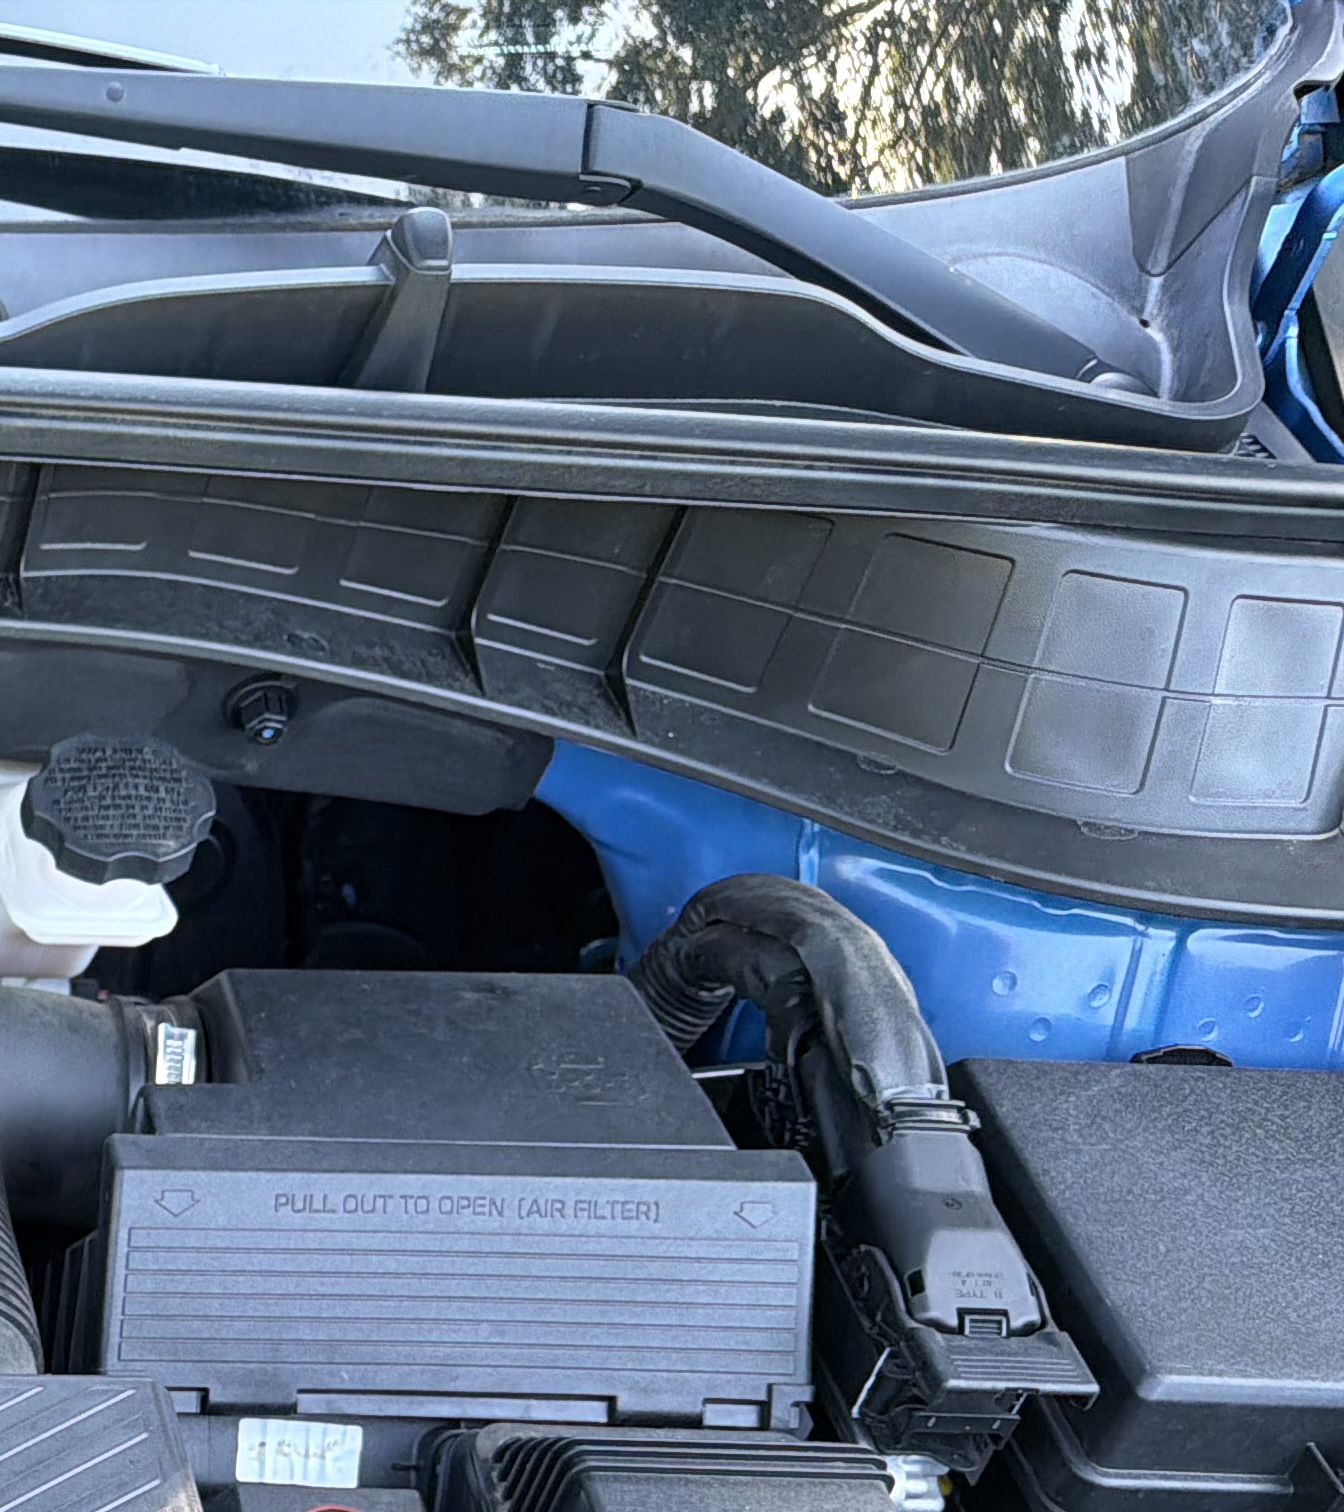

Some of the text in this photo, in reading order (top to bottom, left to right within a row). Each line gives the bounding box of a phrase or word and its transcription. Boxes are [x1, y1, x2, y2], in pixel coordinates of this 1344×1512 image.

[274, 1193, 661, 1223] PULL OUT TO OPEN (AIR FILTER)
